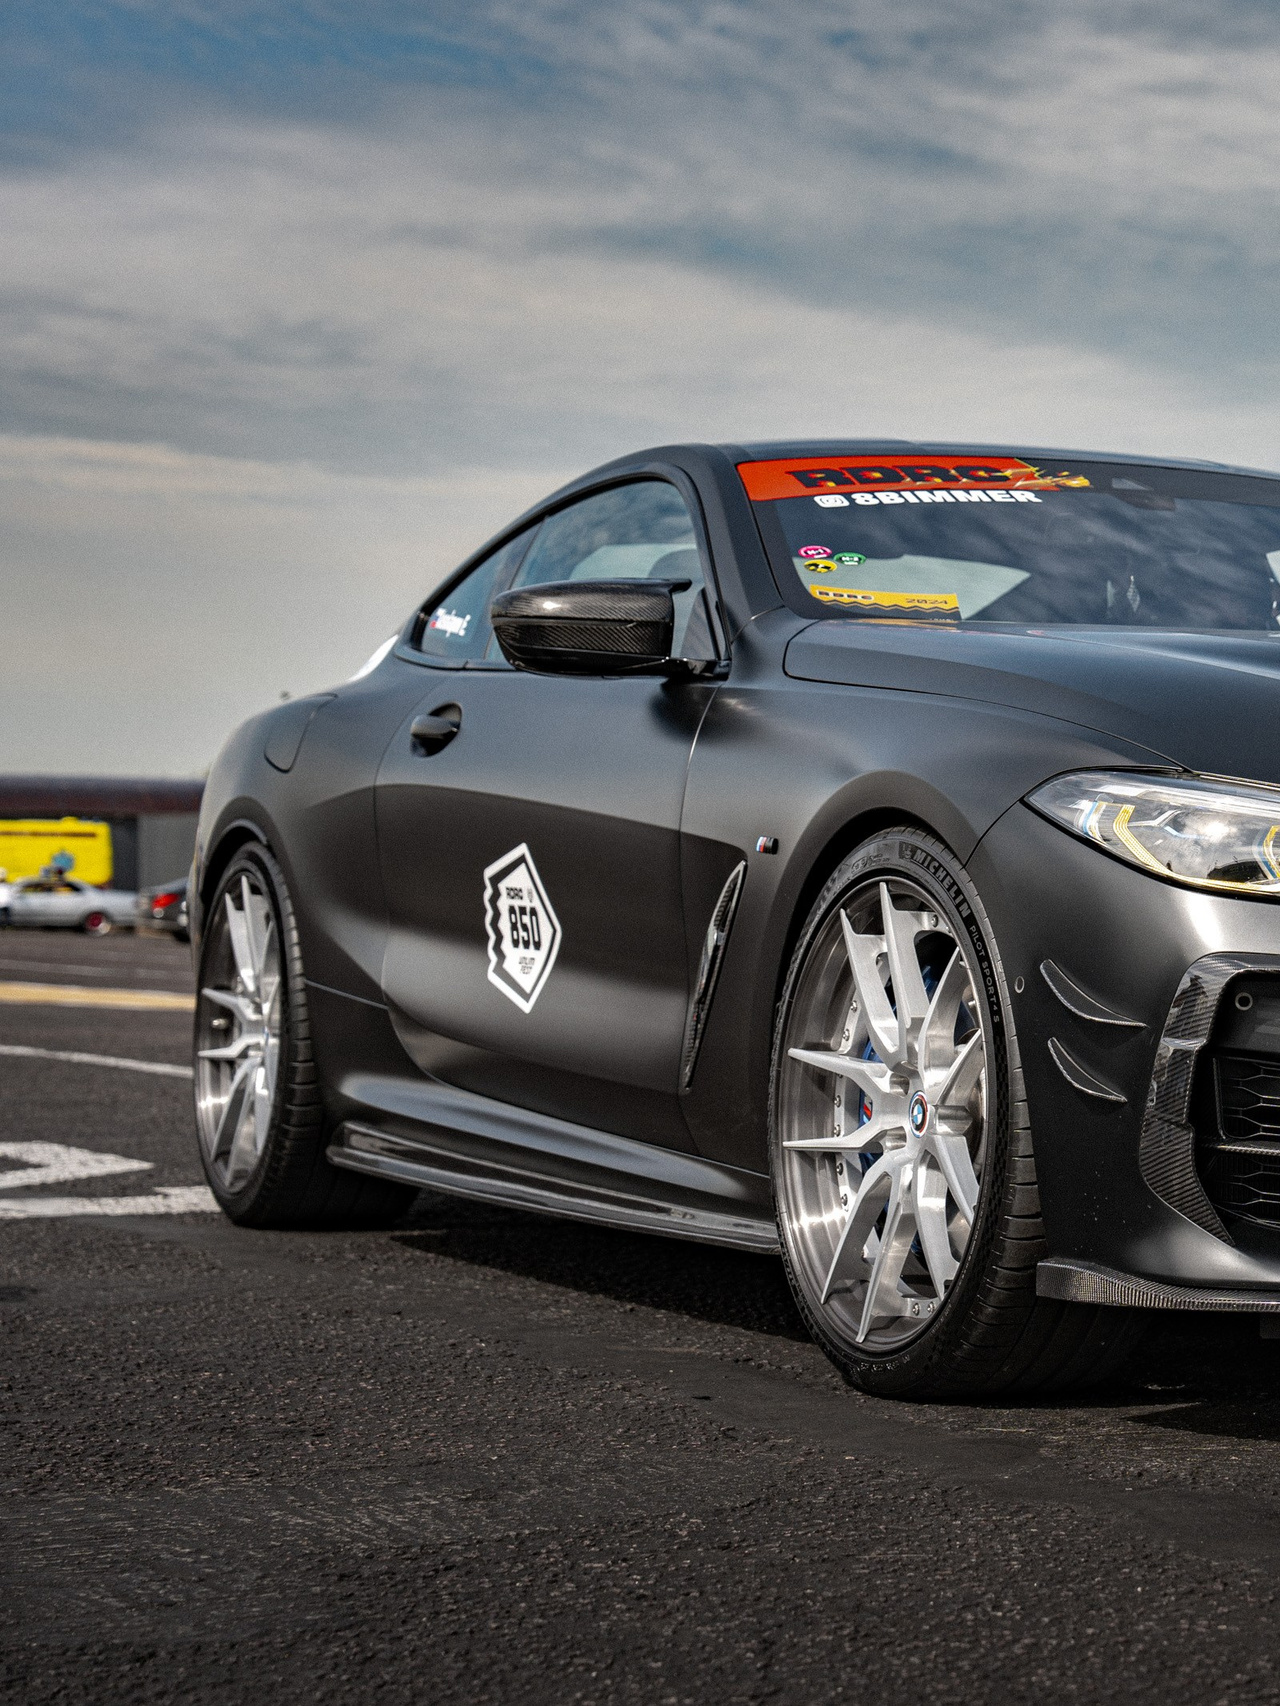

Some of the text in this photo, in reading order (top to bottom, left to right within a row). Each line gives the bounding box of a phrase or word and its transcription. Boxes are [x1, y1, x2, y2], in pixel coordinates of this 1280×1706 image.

[851, 490, 1043, 506] 8BIMMER
[508, 905, 541, 951] 850
[913, 850, 971, 918] MICHELIN
[969, 925, 986, 957] PILOT
[982, 961, 1000, 1004] SPORT
